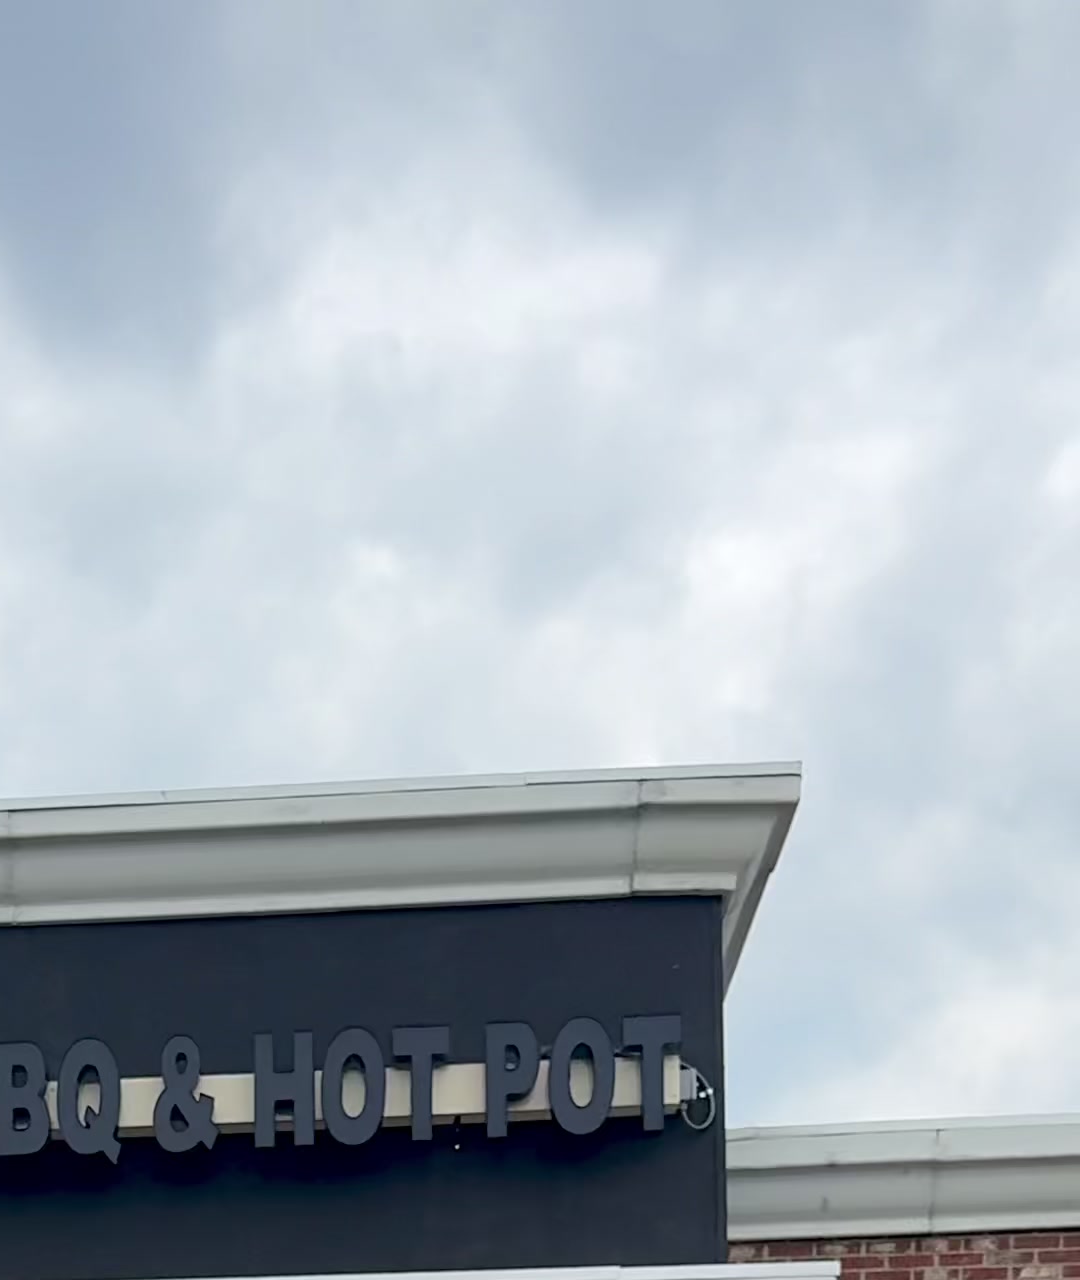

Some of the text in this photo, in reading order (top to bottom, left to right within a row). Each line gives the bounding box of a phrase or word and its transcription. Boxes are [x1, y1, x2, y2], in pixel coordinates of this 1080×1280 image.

[152, 1035, 219, 1152] &
[252, 1024, 451, 1149] HOT
[484, 1015, 682, 1139] POT
